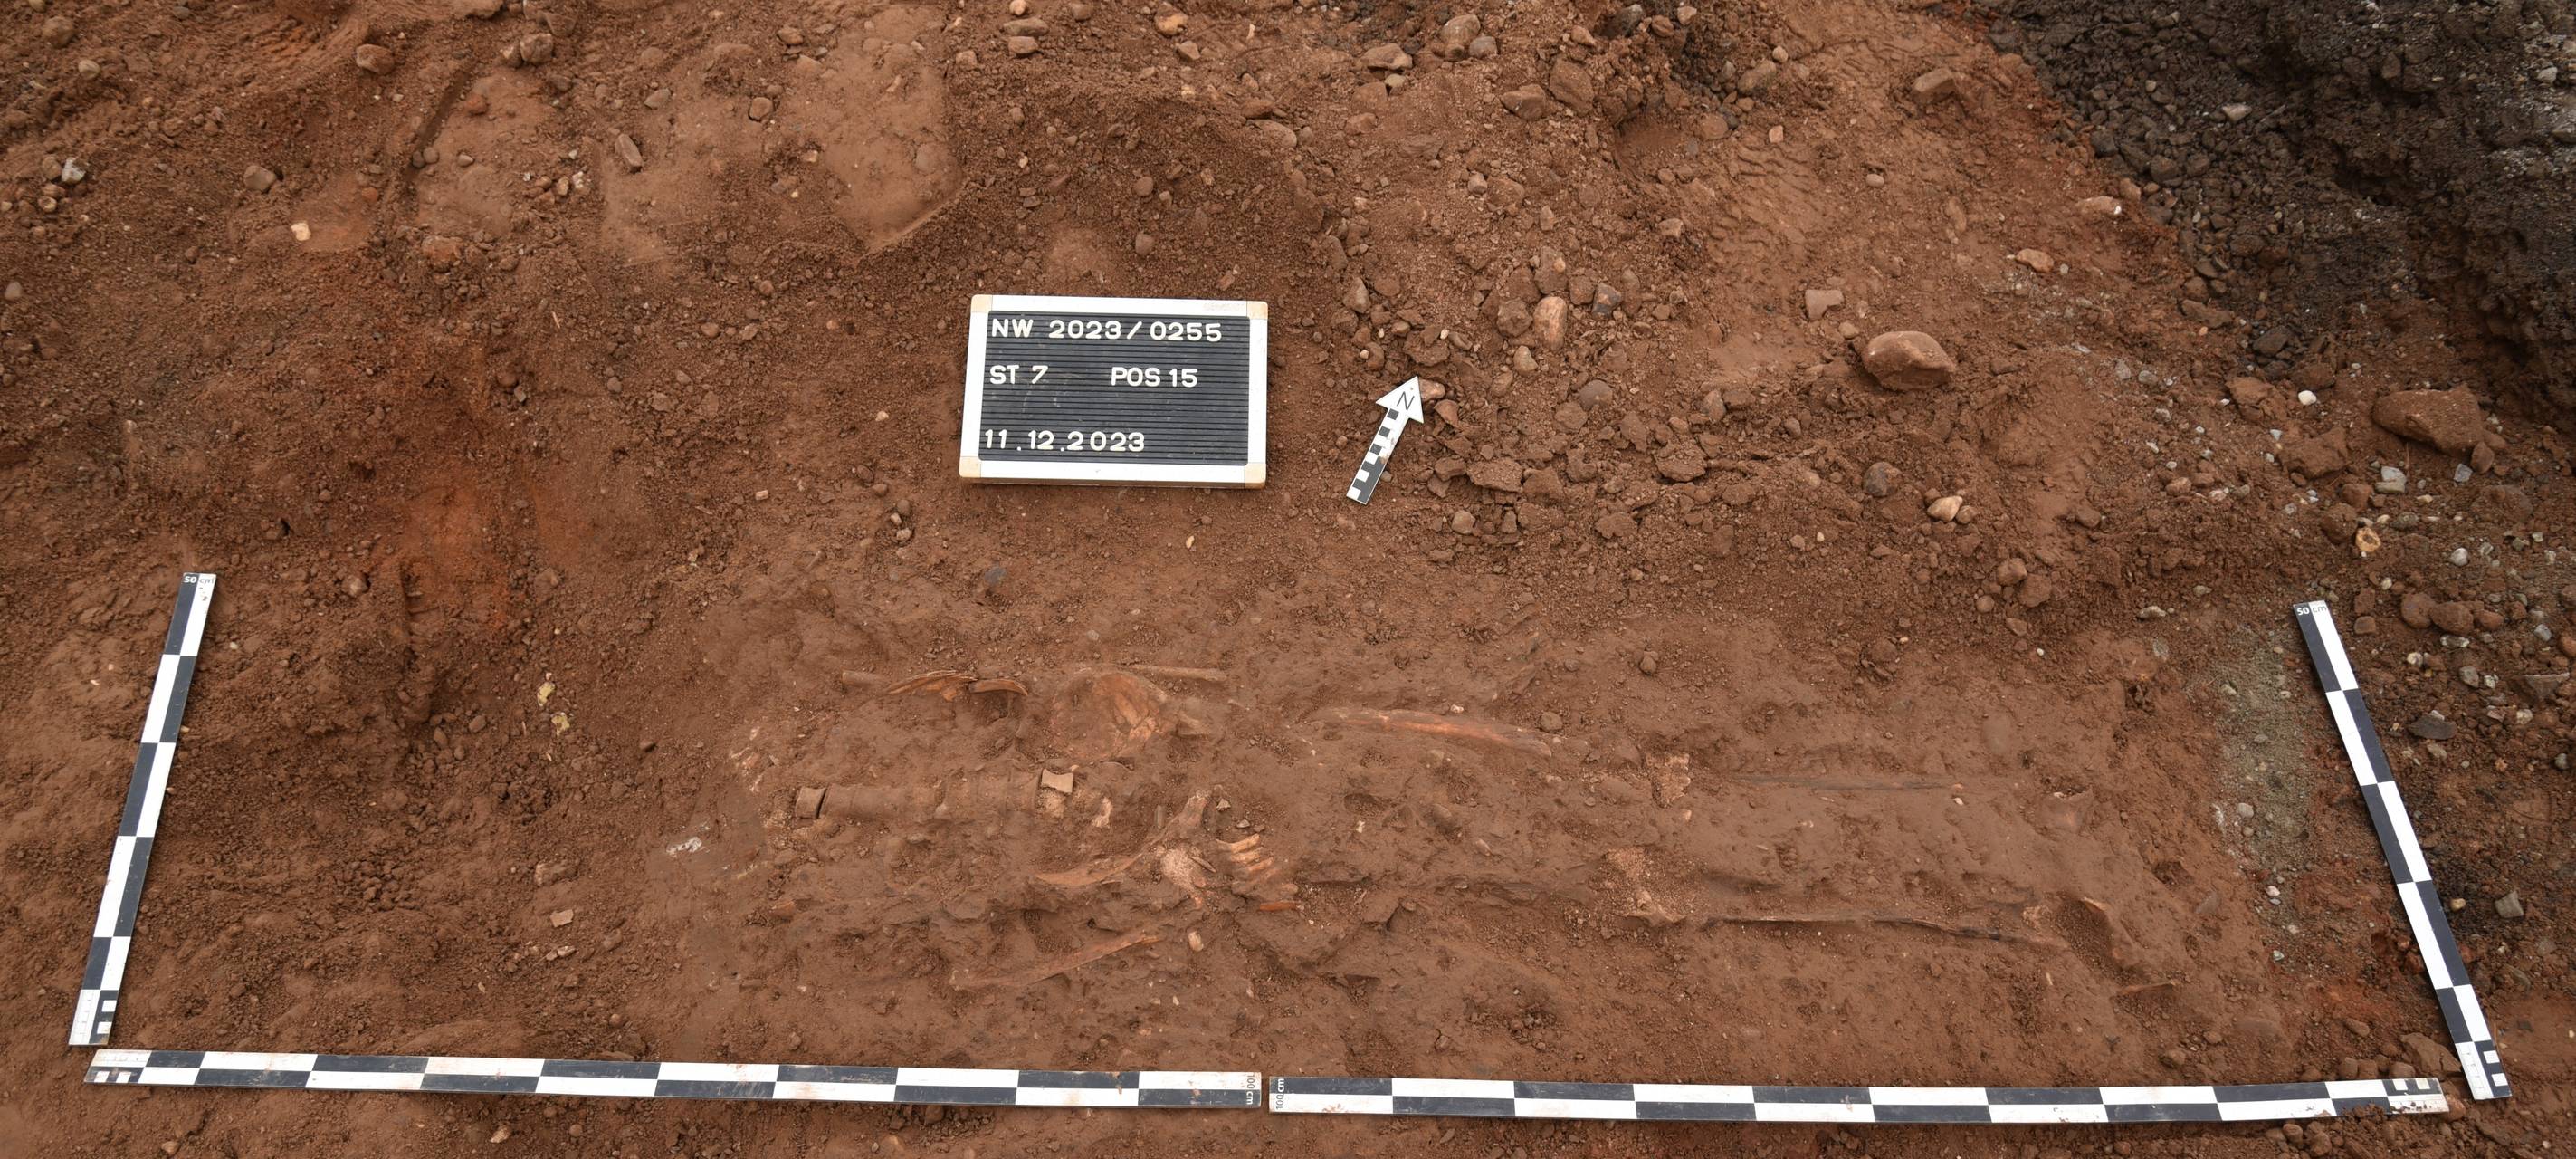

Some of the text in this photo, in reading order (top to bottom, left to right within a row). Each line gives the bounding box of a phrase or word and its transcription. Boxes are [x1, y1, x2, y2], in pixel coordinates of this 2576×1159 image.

[991, 318, 1034, 338] NW
[989, 365, 1198, 388] ST 7 POS 15
[1396, 391, 1415, 410] N
[985, 429, 1145, 452] 11.12.2023
[184, 576, 197, 584] 50
[2296, 607, 2310, 616] 50
